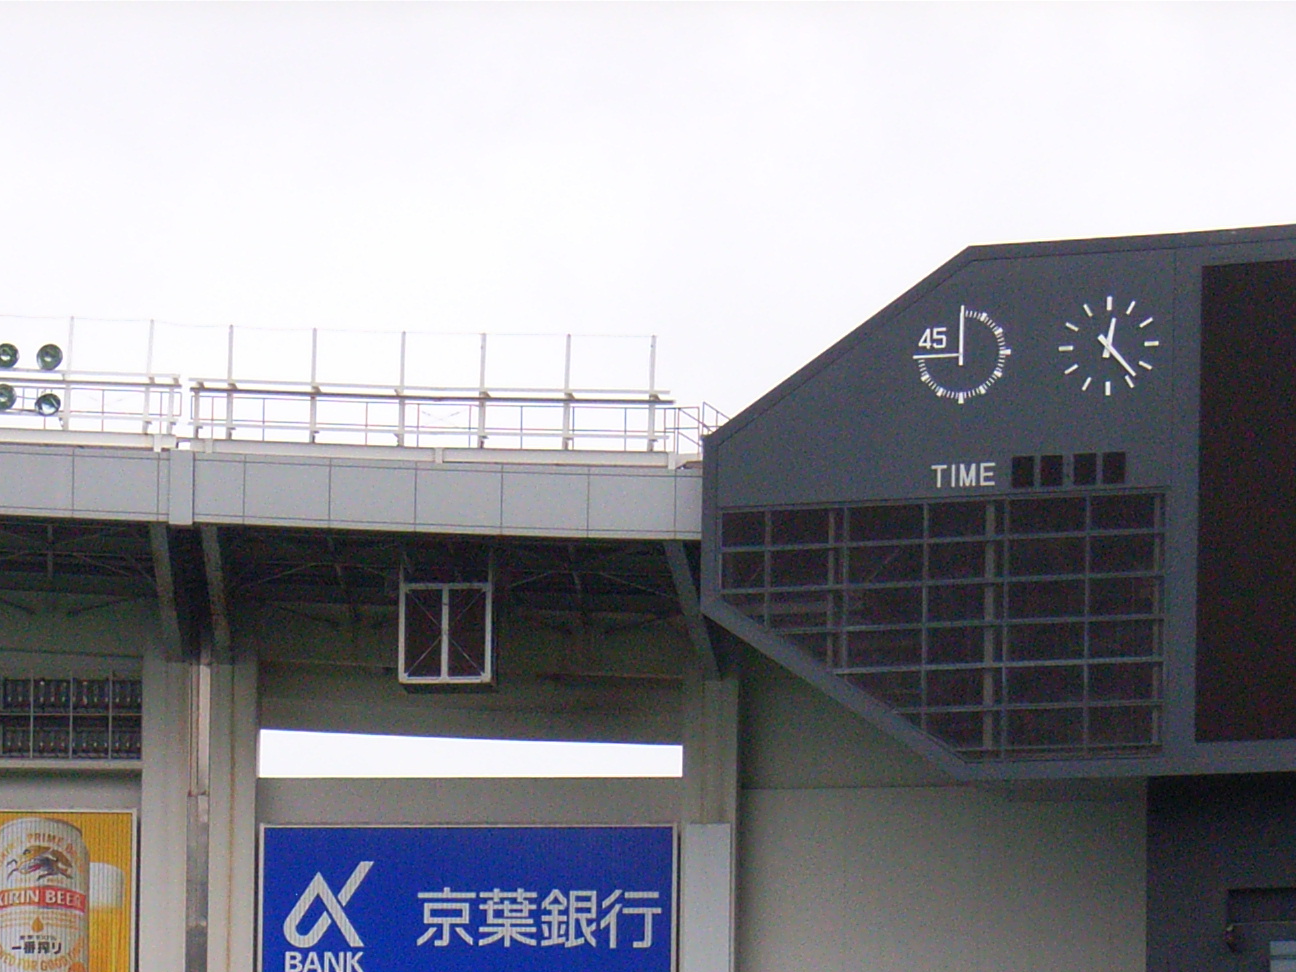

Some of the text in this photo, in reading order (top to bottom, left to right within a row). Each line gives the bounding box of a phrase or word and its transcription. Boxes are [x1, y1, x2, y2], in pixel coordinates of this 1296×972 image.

[919, 328, 947, 350] 45
[931, 463, 996, 488] TIME
[45, 890, 82, 907] BEER
[416, 887, 662, 949] 京葉銀行
